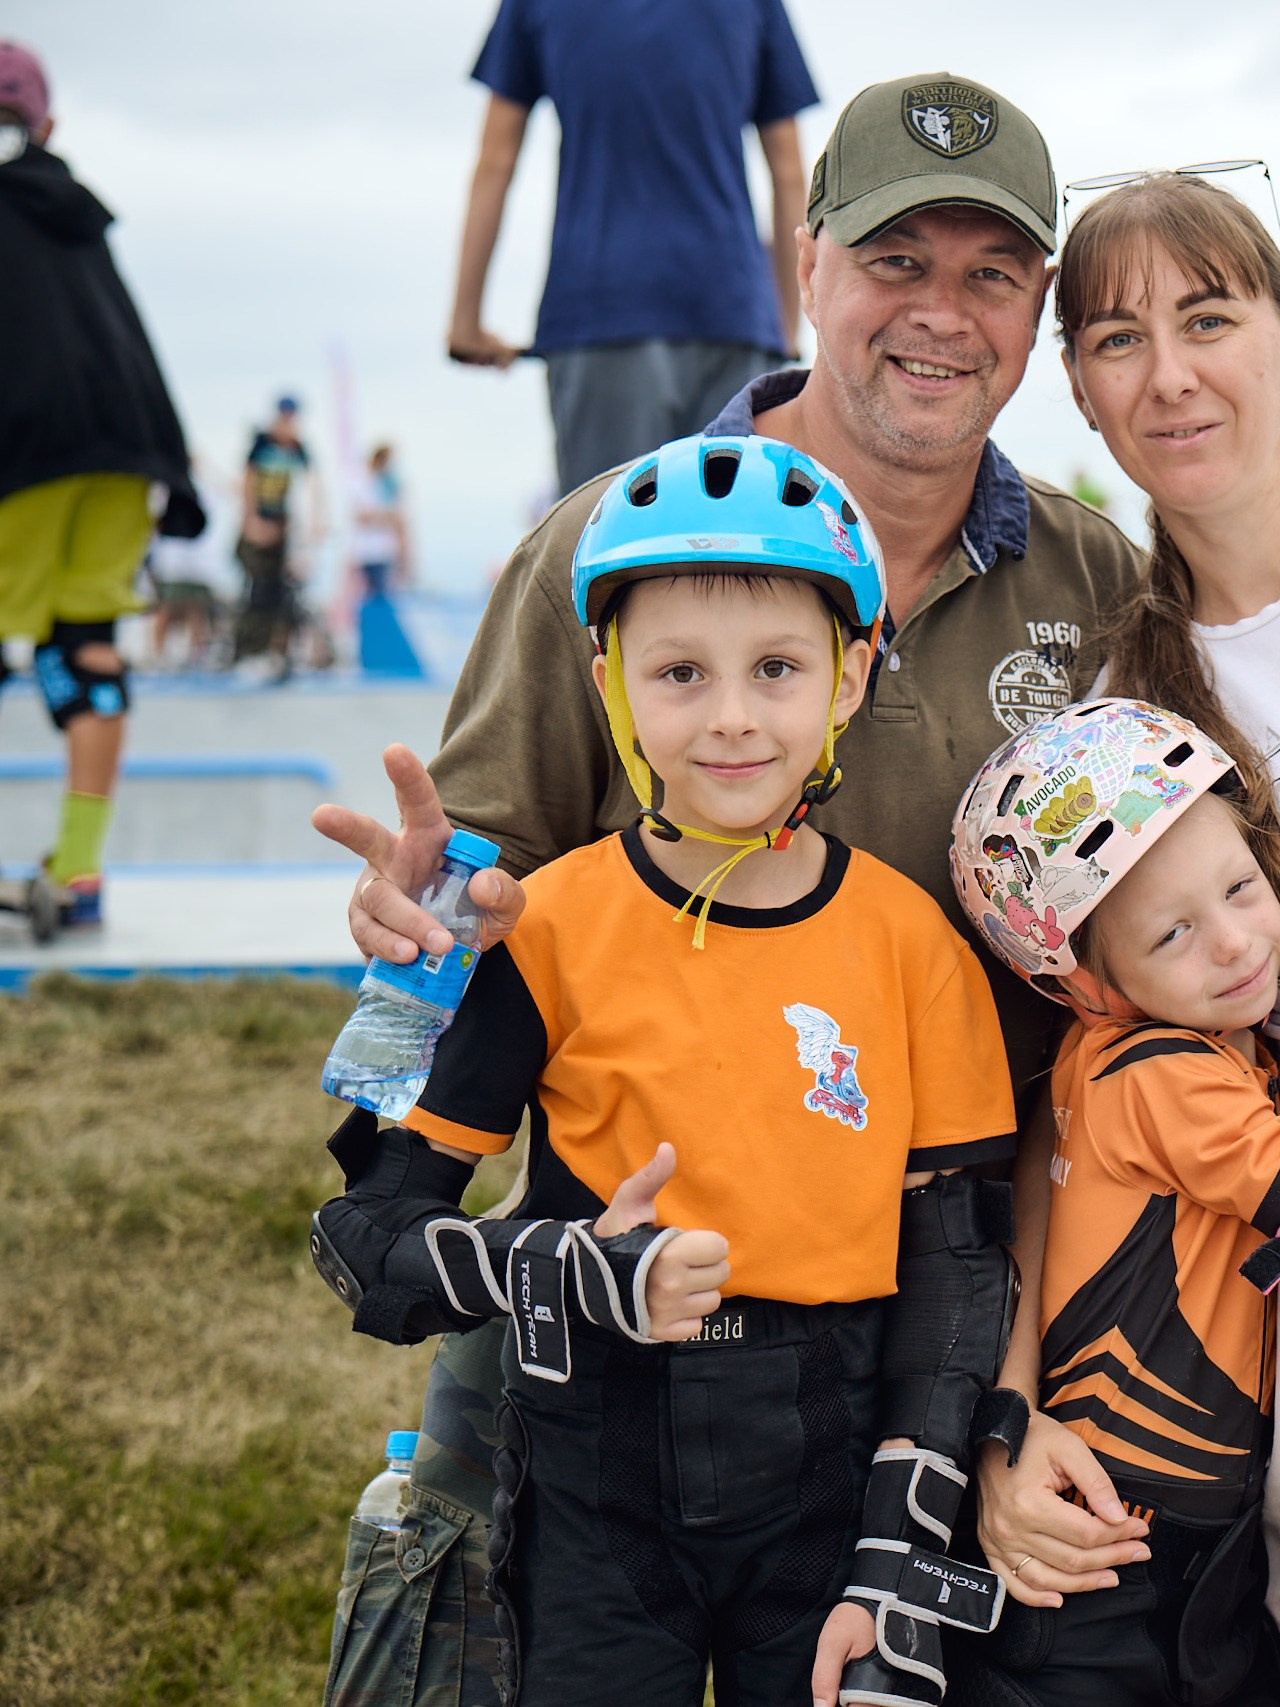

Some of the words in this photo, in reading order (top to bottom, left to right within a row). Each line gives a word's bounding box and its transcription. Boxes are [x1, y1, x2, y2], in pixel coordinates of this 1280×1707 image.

[924, 94, 980, 108] DIVISION
[1026, 621, 1081, 649] 1960
[1000, 688, 1020, 703] BE
[1026, 765, 1077, 816] AVOCADO
[688, 1314, 744, 1342] ield
[913, 1559, 990, 1595] TECHTEAM
